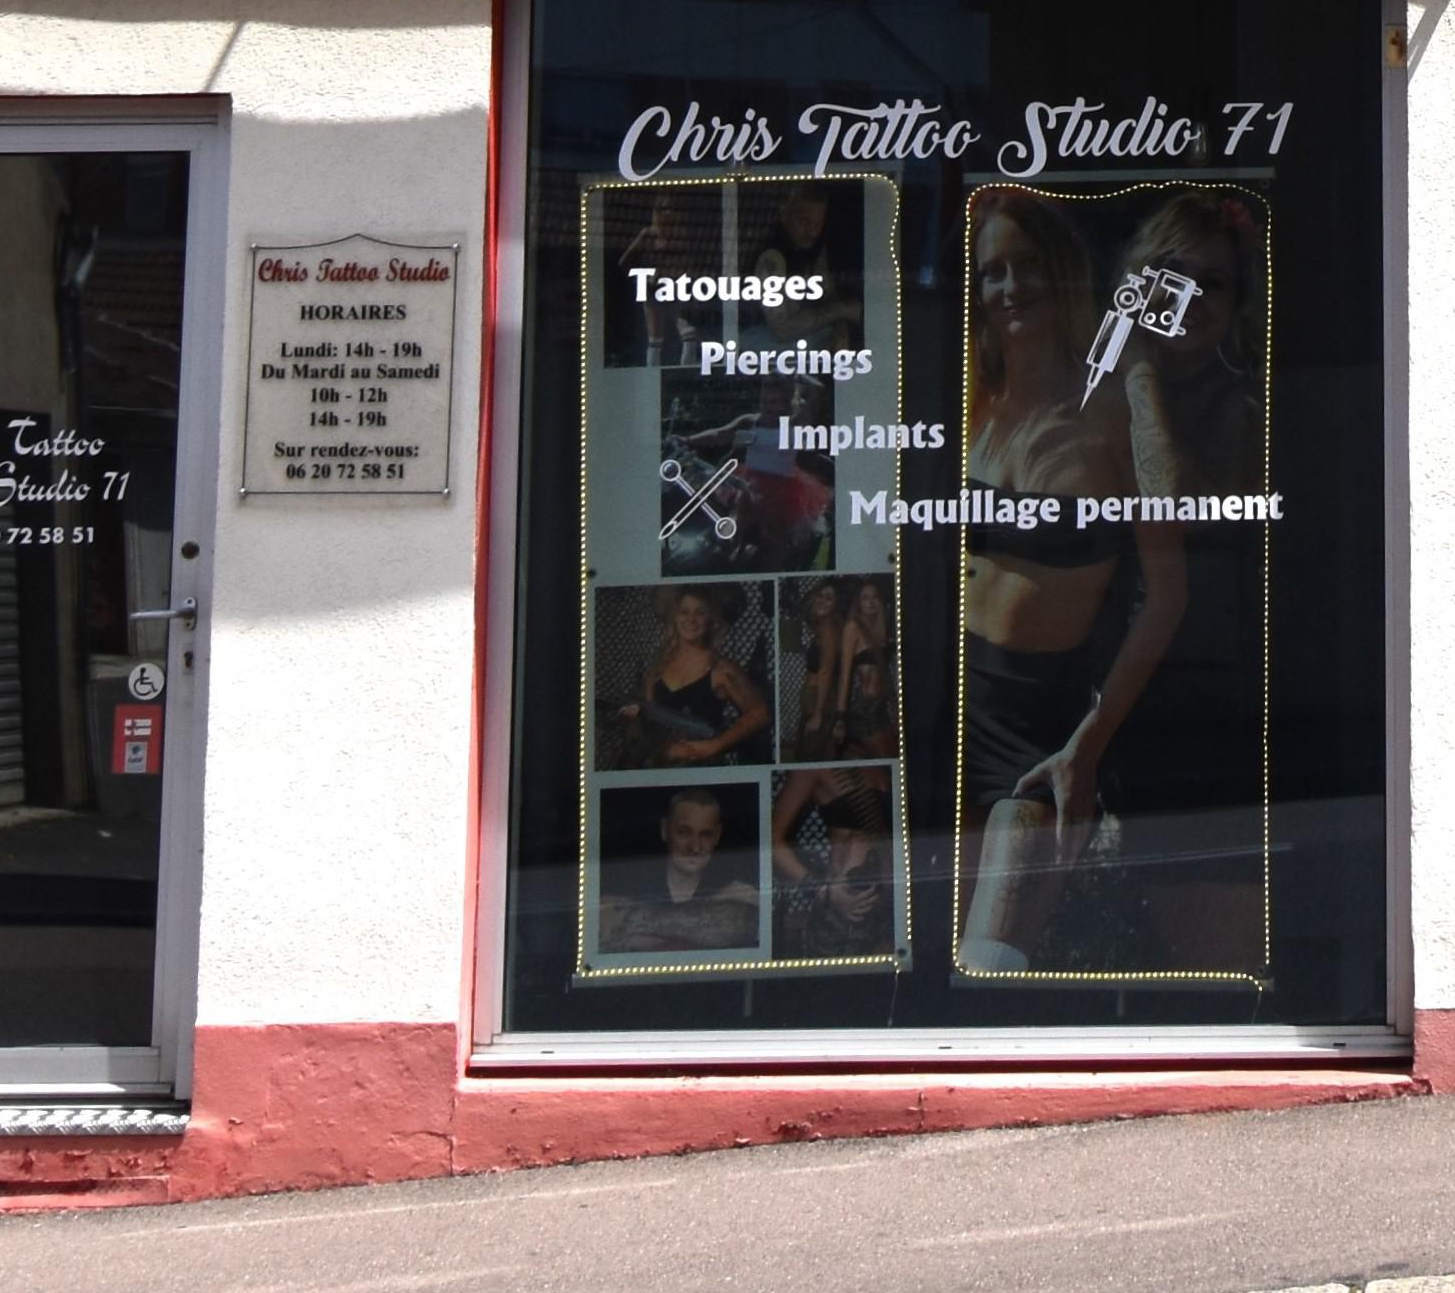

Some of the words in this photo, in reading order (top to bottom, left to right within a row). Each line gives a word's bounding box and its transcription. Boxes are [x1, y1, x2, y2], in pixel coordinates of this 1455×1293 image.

[618, 101, 782, 180] Chris
[799, 98, 980, 176] Tattoo
[998, 96, 1201, 177] Studio
[1223, 103, 1294, 156] 71
[258, 258, 308, 282] Chris
[316, 258, 379, 282] Tattoo
[386, 257, 450, 282] Studio
[629, 268, 824, 308] Tatouages
[300, 305, 407, 320] HORAIRES
[281, 343, 338, 357] Lundi:
[345, 343, 374, 357] 14h
[394, 343, 422, 357] 19h
[701, 340, 873, 380] Piercings
[261, 365, 285, 379] Du
[292, 364, 345, 379] Mardi
[351, 368, 370, 379] au
[377, 364, 440, 379] Samedi
[311, 388, 339, 402] 10h
[359, 388, 387, 402] 12h
[310, 412, 338, 426] 14h
[357, 412, 386, 426] 19h
[8, 416, 105, 456] Tattoo
[778, 416, 946, 457] Implants
[274, 442, 305, 457] Sur
[310, 443, 419, 457] rendez-vous:
[286, 464, 306, 479] 06
[311, 464, 331, 479] 20
[337, 464, 355, 479] 72
[361, 464, 381, 479] 58
[386, 464, 405, 479] 51
[103, 471, 130, 501] 71
[850, 490, 1061, 531] Maquillage
[1077, 495, 1284, 530] permanent
[7, 527, 33, 544] 72
[39, 527, 64, 544] 58
[72, 527, 94, 544] 51
